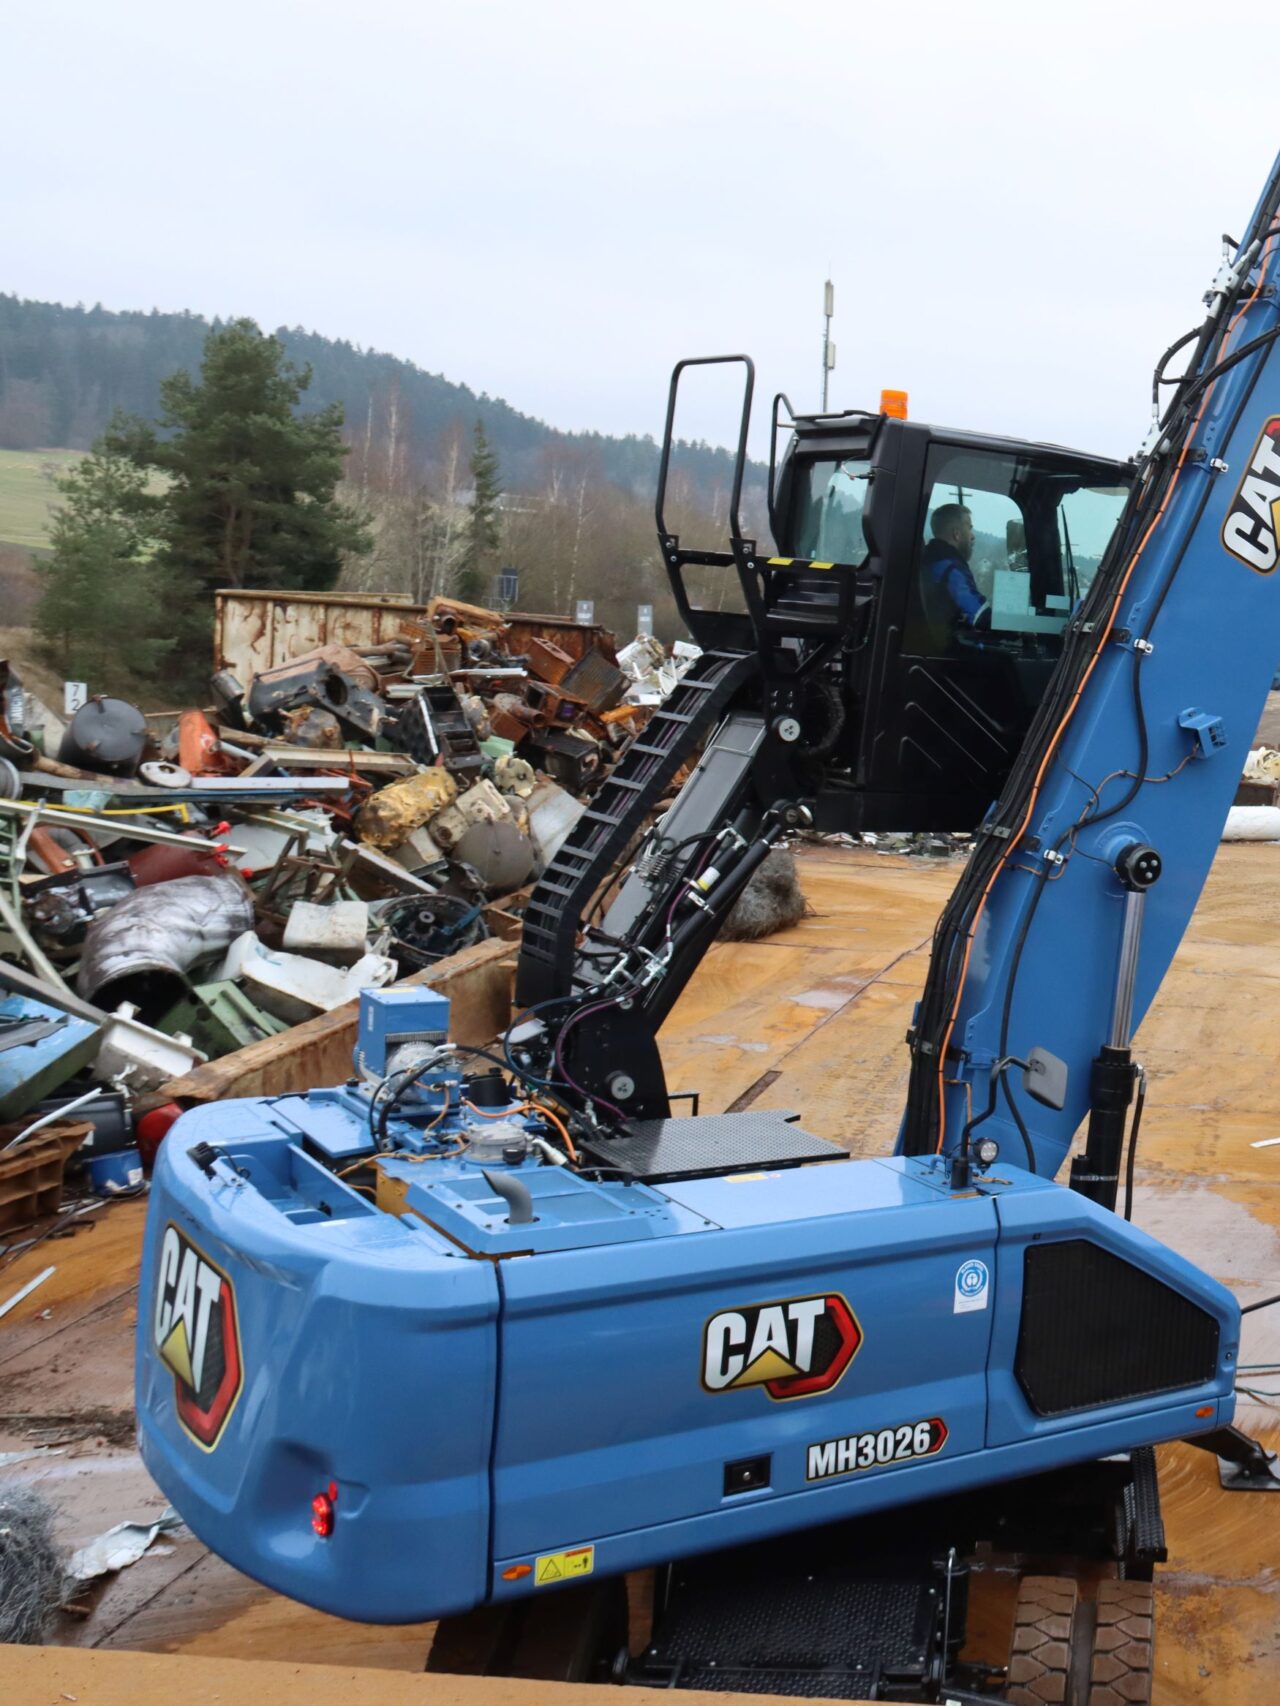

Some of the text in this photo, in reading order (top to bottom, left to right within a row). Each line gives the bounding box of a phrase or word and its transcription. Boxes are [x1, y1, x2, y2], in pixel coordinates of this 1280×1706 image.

[72, 684, 80, 697] 7
[72, 698, 81, 711] 2
[155, 1227, 221, 1393] CAT
[704, 1298, 825, 1390] CAT
[807, 1422, 931, 1480] MH3026
